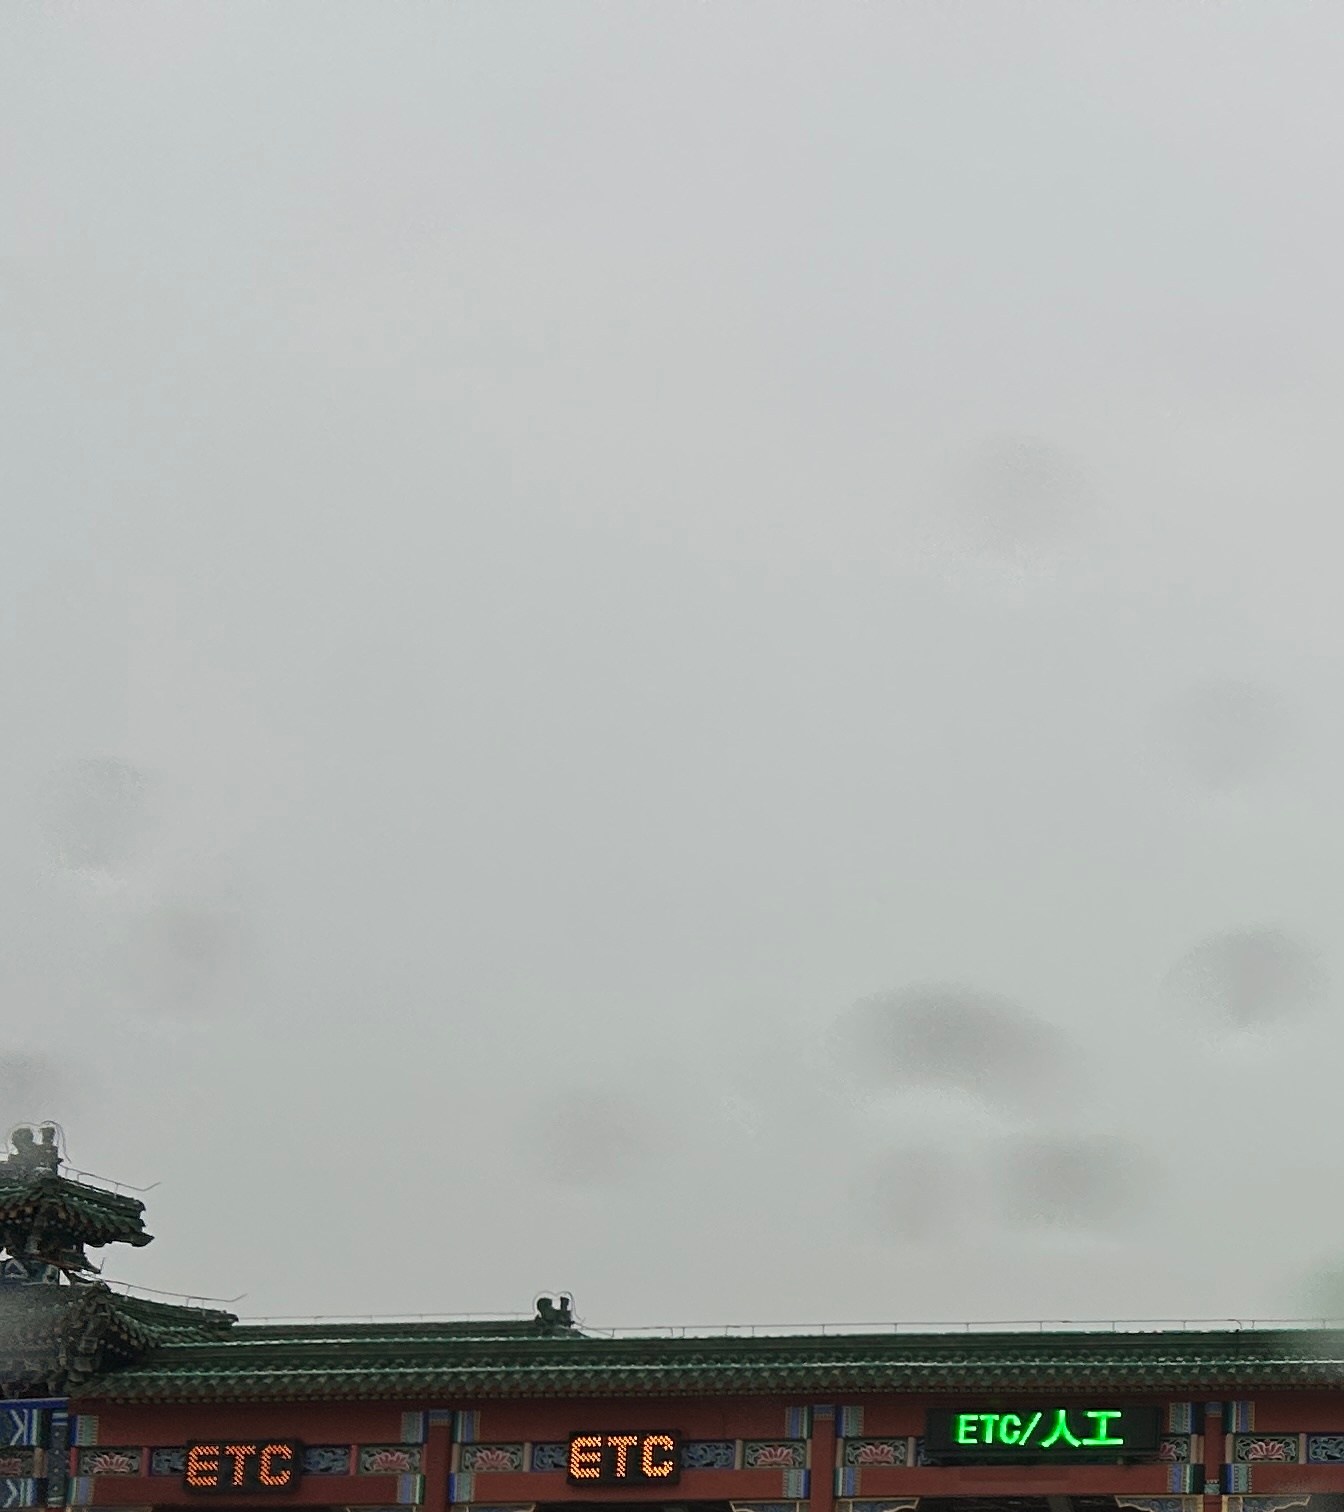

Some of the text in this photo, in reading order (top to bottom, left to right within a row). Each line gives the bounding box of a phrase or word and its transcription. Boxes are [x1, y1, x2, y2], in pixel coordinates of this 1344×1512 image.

[957, 1409, 1124, 1447] ETC/人工
[185, 1444, 294, 1488] ETC
[569, 1435, 675, 1479] ETC
